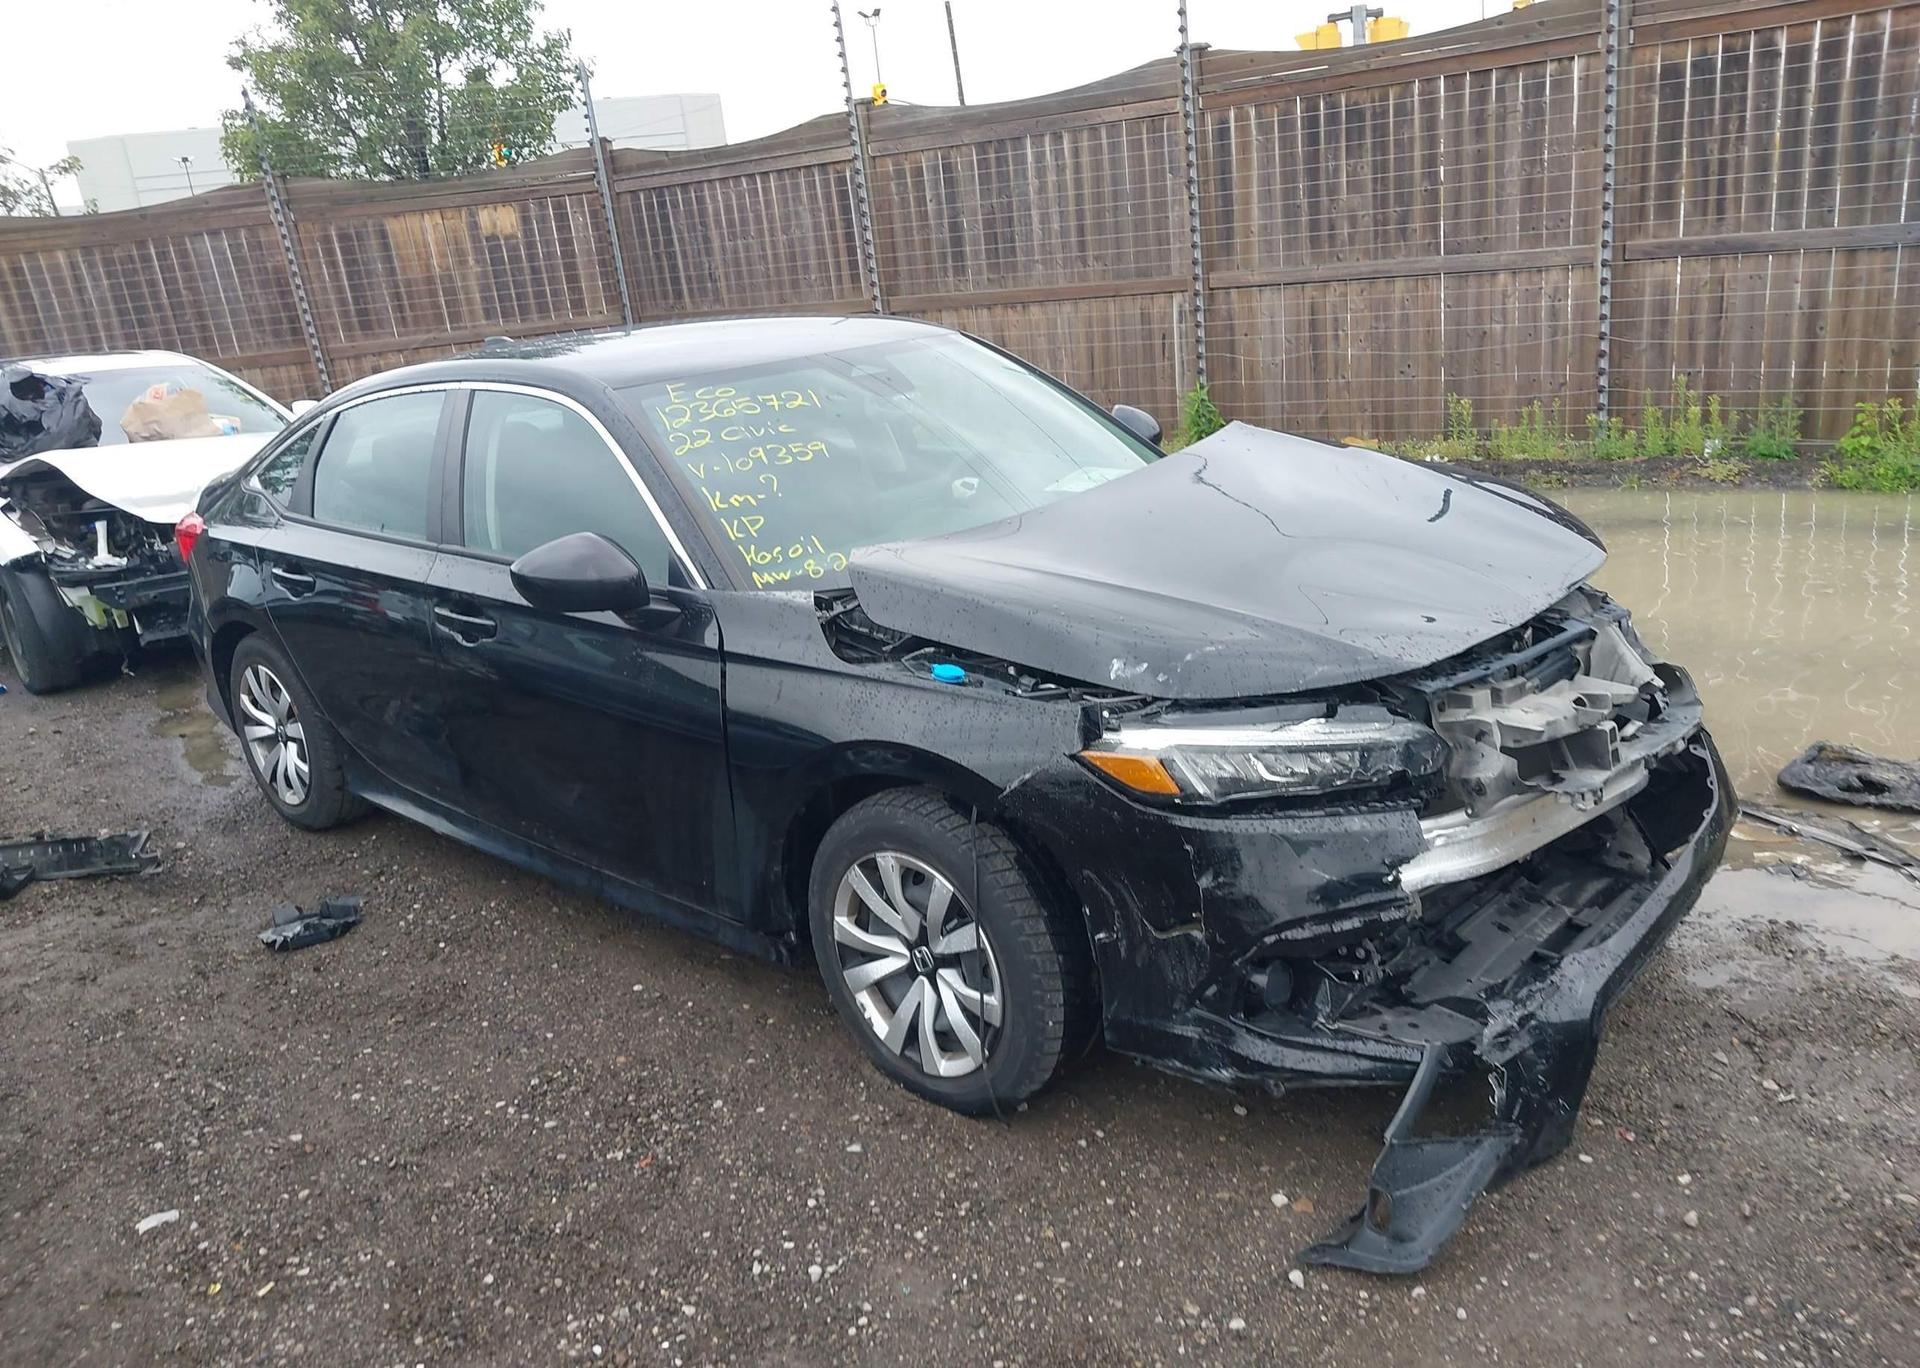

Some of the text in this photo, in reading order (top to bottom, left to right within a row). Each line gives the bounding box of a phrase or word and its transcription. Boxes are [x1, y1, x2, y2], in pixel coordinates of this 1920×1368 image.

[655, 388, 823, 432] 12365721
[668, 428, 715, 457] 22
[719, 515, 766, 542] KP
